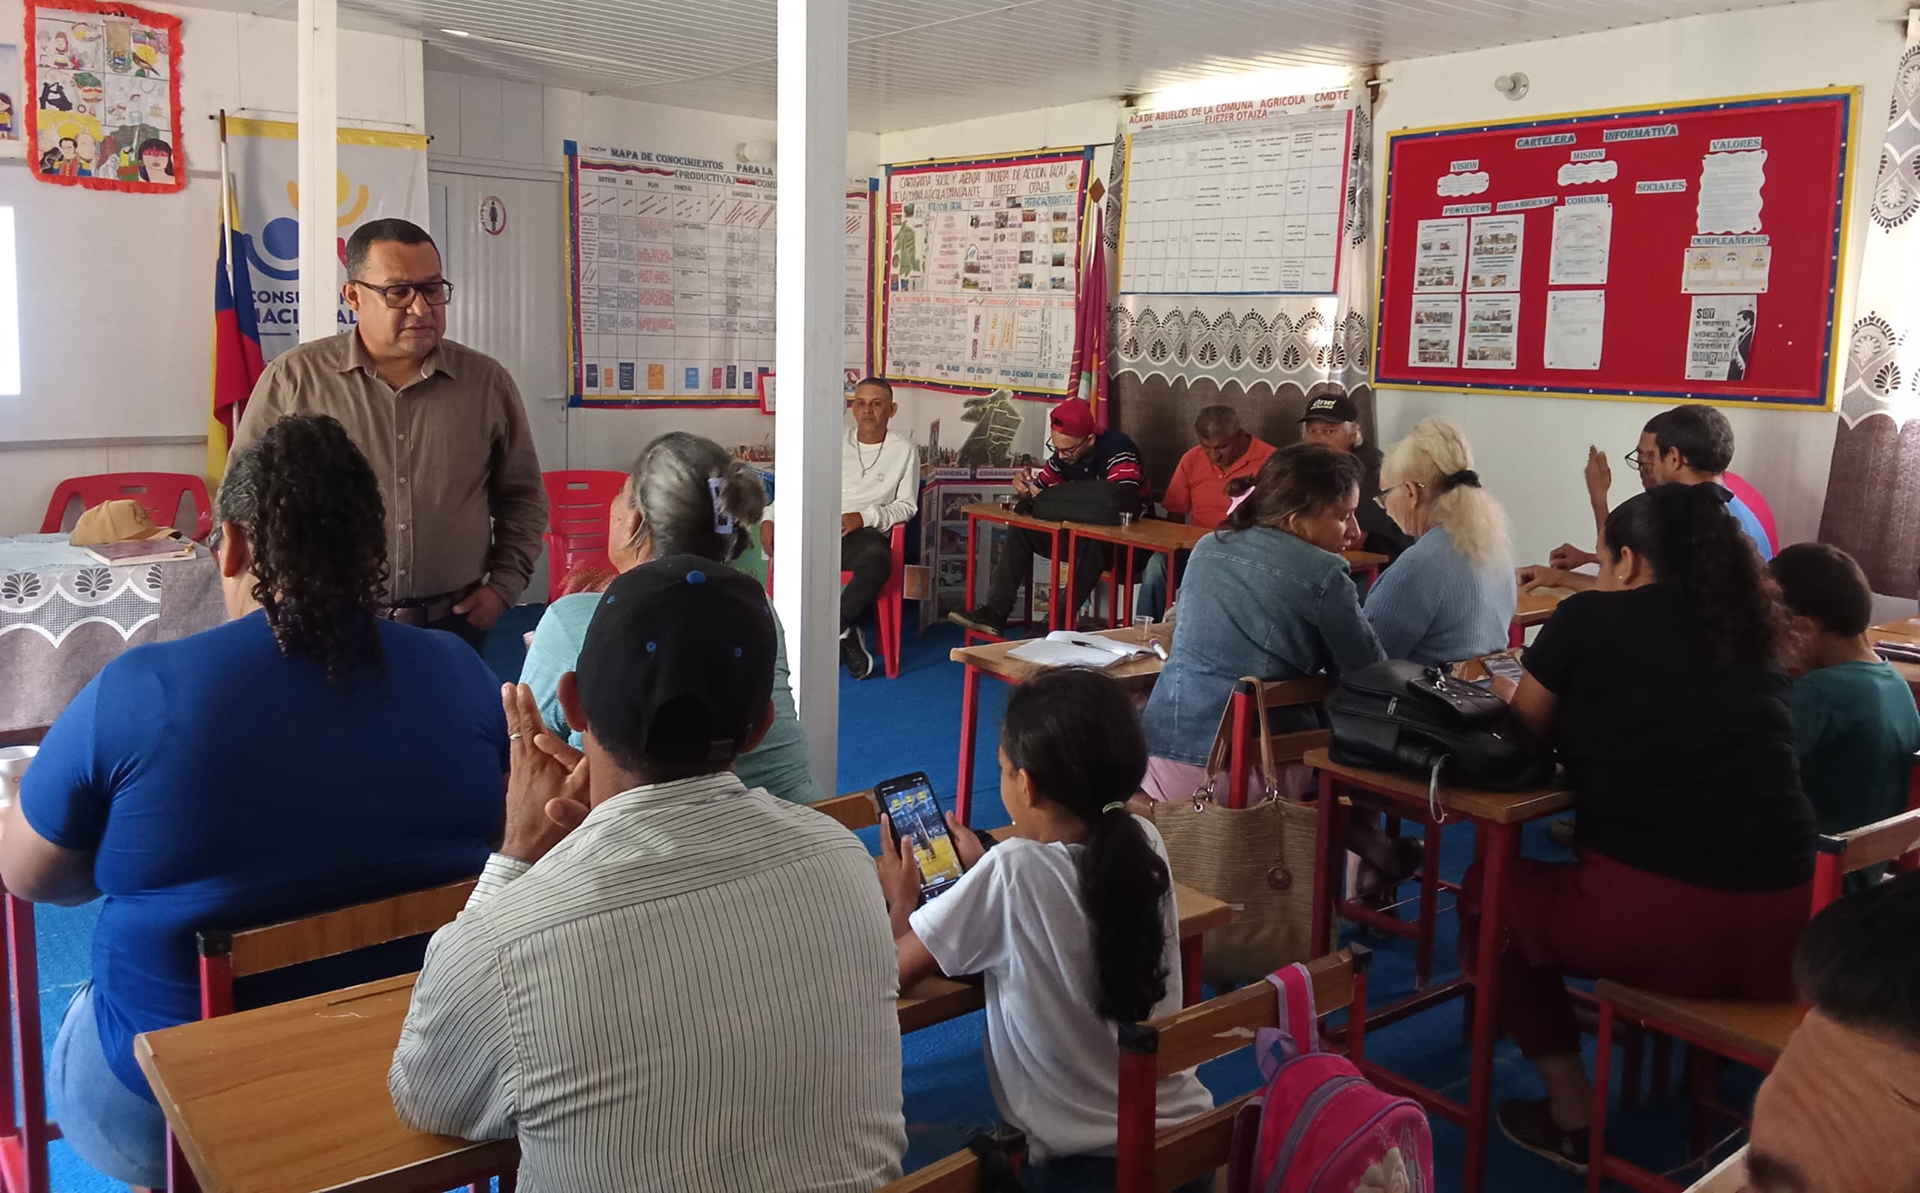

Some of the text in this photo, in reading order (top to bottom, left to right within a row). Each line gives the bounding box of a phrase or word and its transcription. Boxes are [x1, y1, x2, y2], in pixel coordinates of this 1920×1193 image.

[1129, 90, 1350, 124] ACA DE ABUELOS DE LA COMUNA AGRICOLA CMDTE
[1204, 109, 1268, 124] ELIEZER OTAIZA
[1516, 126, 1677, 148] CARTELERA INFORMATIVA
[1712, 139, 1760, 150] VALORES
[1572, 150, 1604, 161] MISION
[611, 149, 638, 161] MAPA
[641, 153, 653, 162] DE
[656, 154, 724, 170] CONOCIMIENTOS
[736, 164, 760, 174] PARA
[761, 165, 774, 176] LA
[1451, 161, 1478, 171] VISION
[1637, 181, 1685, 192] SOCIALES
[1498, 197, 1557, 210] ORGANIGRAMA
[1566, 196, 1606, 205] COMUNAL
[1444, 204, 1491, 215] PROYECTOS
